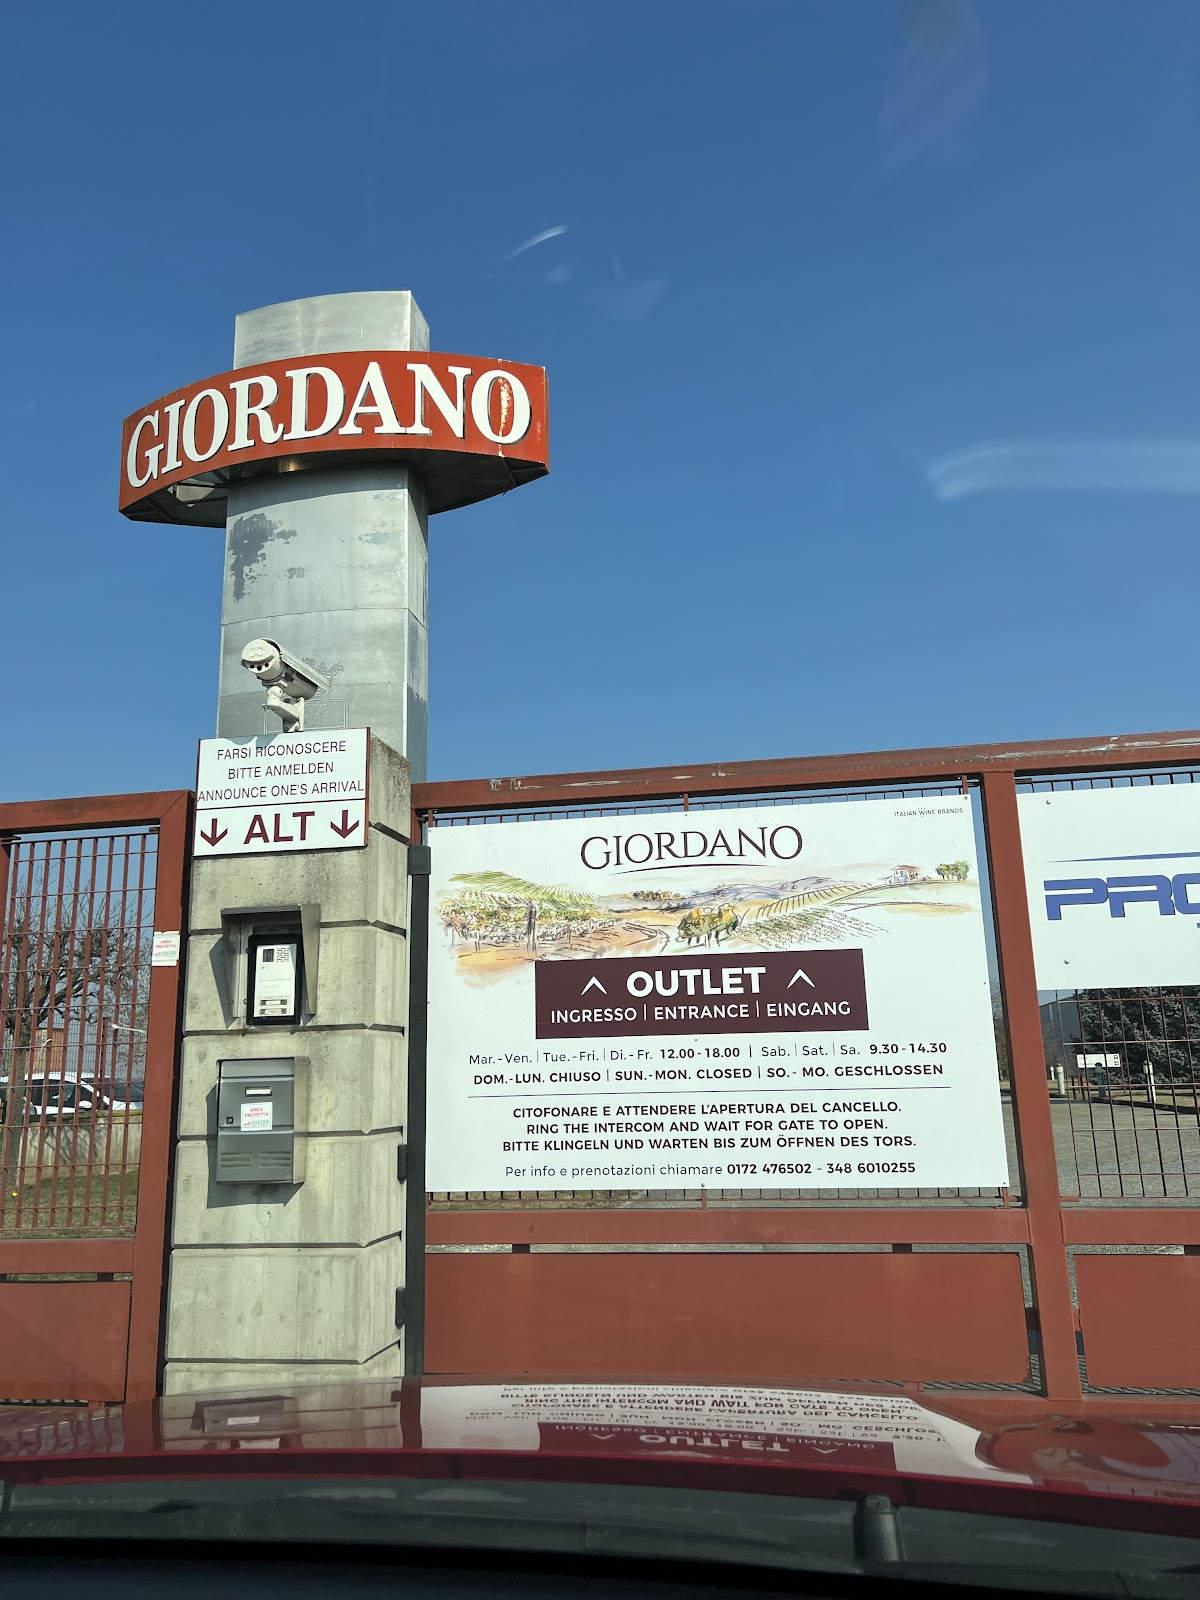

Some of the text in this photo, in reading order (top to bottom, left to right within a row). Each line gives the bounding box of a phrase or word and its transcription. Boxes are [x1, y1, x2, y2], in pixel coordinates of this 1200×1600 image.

[126, 361, 531, 488] GIORDANO
[216, 740, 346, 761] FARSI RICONOSCERE
[228, 761, 334, 780] BITTE ANMELDEN
[197, 780, 364, 803] ANNOUNCE ONE'S ARRIVAL
[918, 808, 935, 817] WINE
[937, 807, 964, 815] BRANDS
[243, 810, 316, 845] ALT
[580, 825, 803, 870] GIORDANO
[626, 966, 767, 998] OUTLET
[551, 1000, 851, 1024] INGRESSO ENTRANCE EINGANG
[761, 1045, 790, 1057] Sab.
[802, 1045, 828, 1056] Sat.
[840, 1044, 861, 1055] Sa.
[549, 1071, 601, 1083] CHIUSO
[696, 1068, 752, 1080] CLOSED
[834, 1064, 943, 1077] GESCHLOSSEN
[513, 1101, 902, 1118] CITOFONARE E ATTENDERE L’APERTURA DEL CANCELLO.
[526, 1118, 888, 1135] RING THE INTERCOM AND WAIT FOR GATE TO OPEN.
[503, 1134, 917, 1152] BITTE KLINGELN UND WARTEN BIS ZUM ÖFFNEN DES TORS.
[505, 1166, 527, 1177] Per
[530, 1165, 556, 1177] info
[559, 1167, 568, 1177] e
[572, 1164, 655, 1179] prenotazioni
[659, 1163, 723, 1175] chiamare
[727, 1163, 758, 1175] 0172
[762, 1163, 812, 1174] 476502
[826, 1162, 853, 1174] 348
[857, 1162, 916, 1174] 6010255
